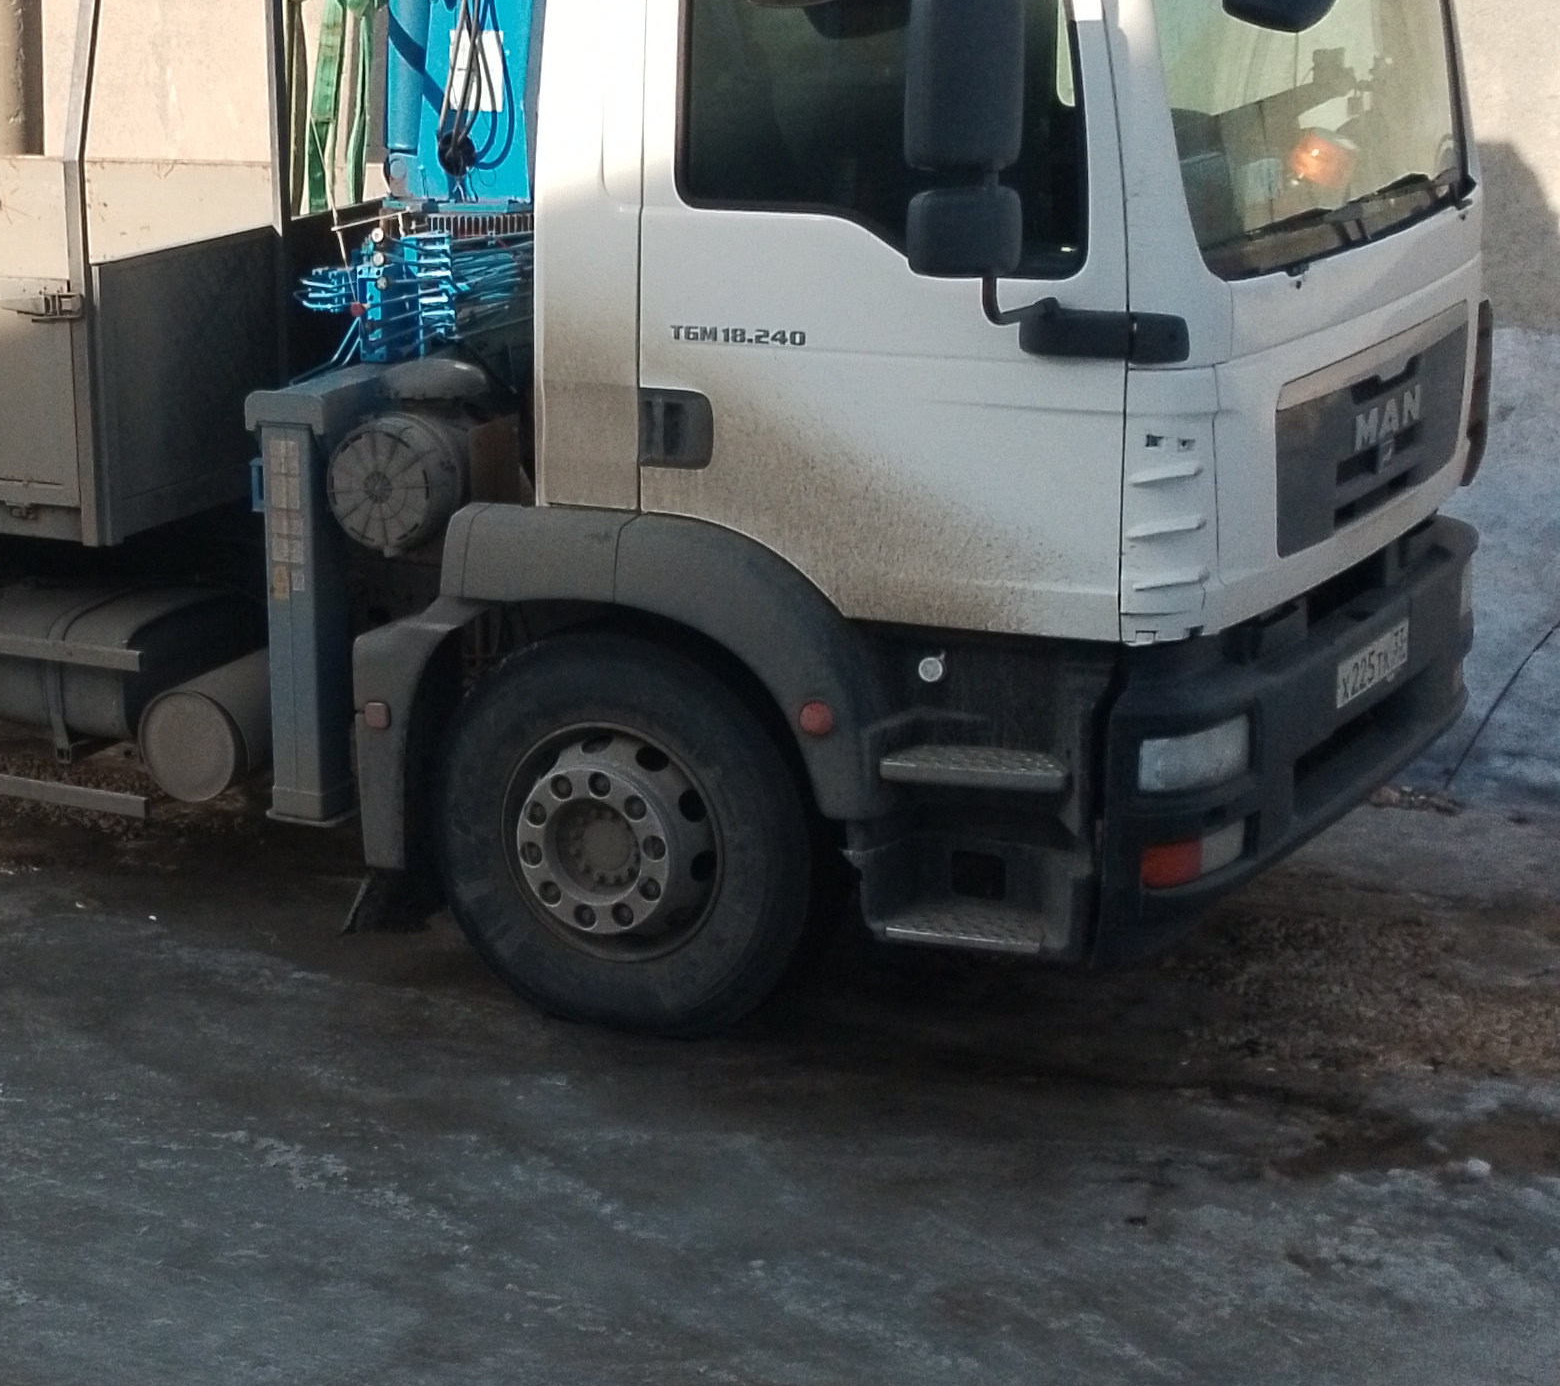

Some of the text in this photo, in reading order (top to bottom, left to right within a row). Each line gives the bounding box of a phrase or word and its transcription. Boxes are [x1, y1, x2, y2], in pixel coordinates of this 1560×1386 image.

[670, 324, 806, 346] TGM 18.240
[1354, 382, 1421, 451] MAN
